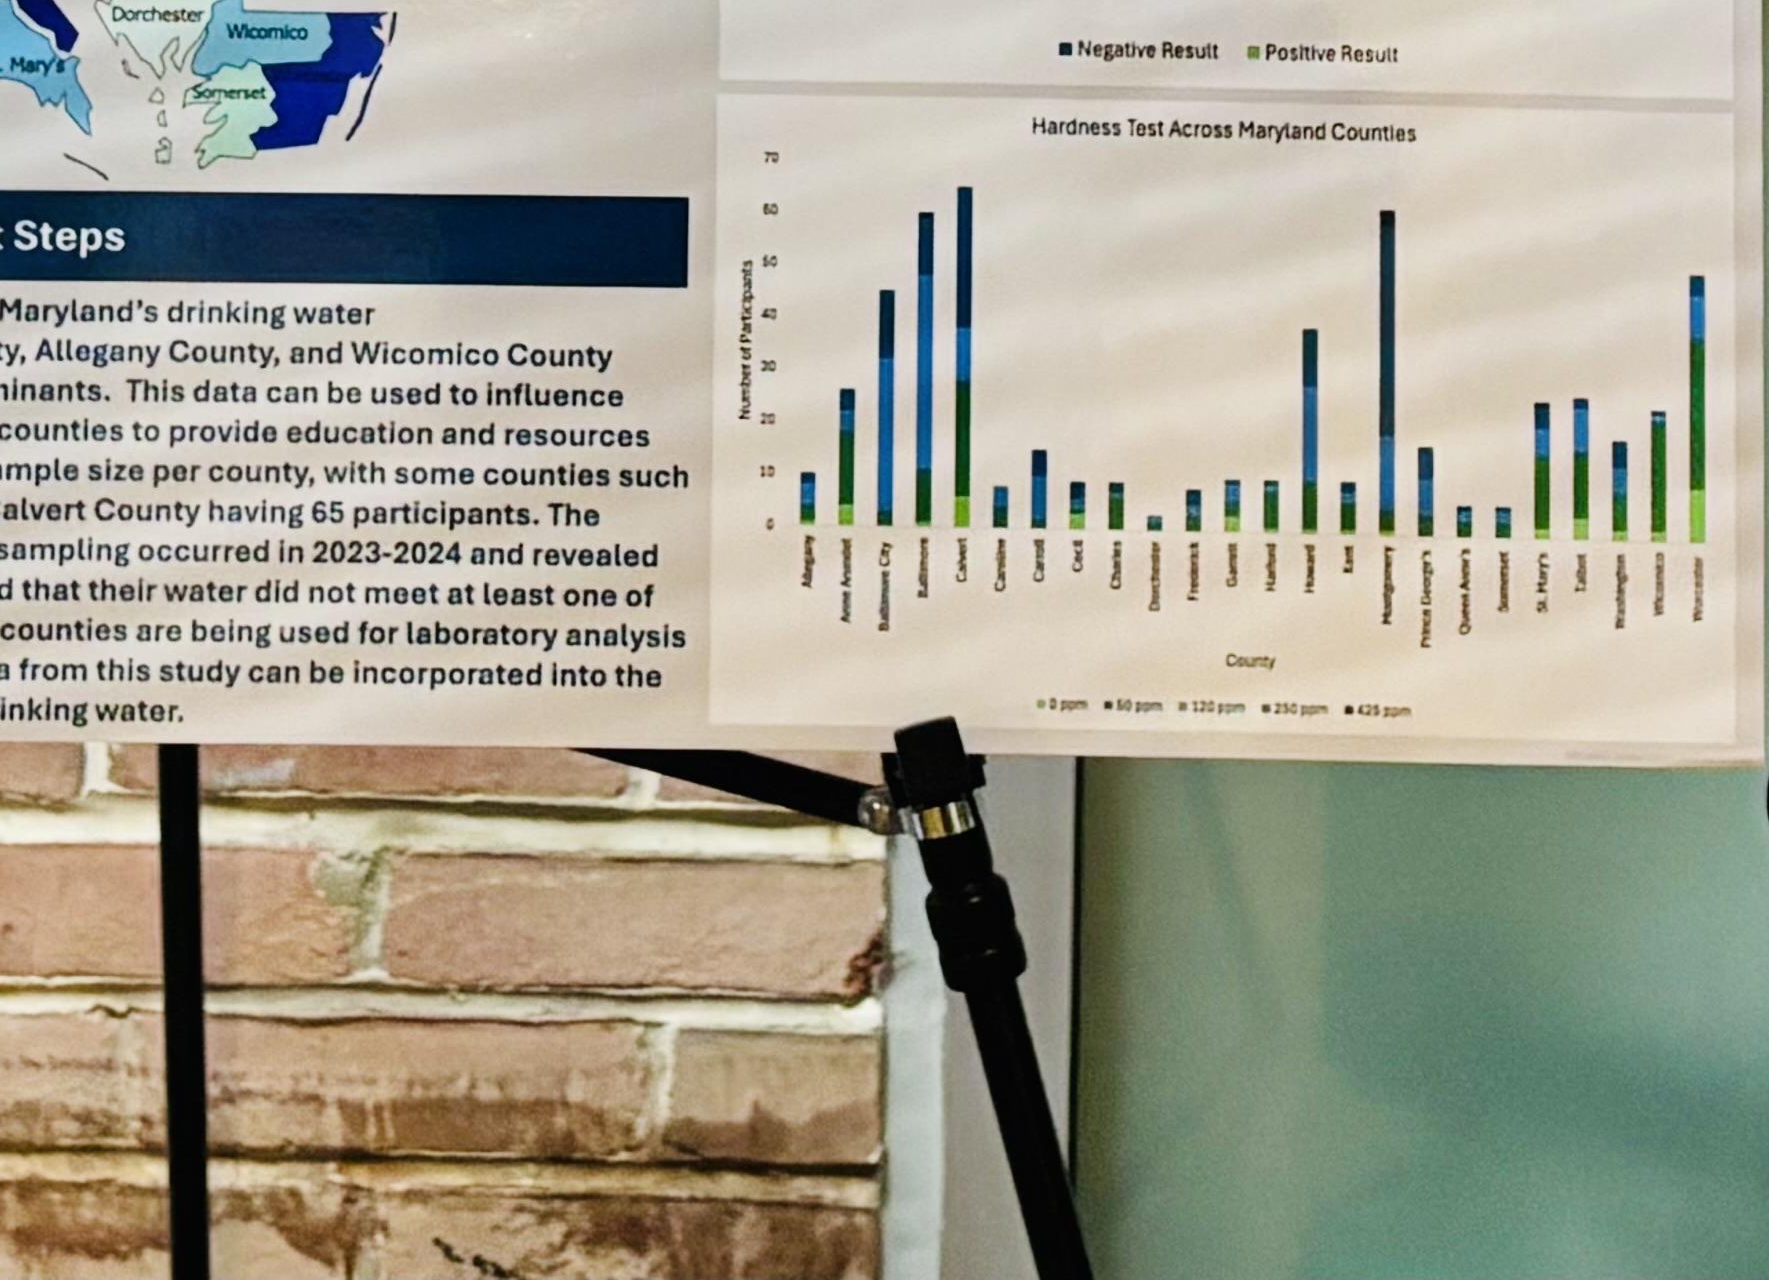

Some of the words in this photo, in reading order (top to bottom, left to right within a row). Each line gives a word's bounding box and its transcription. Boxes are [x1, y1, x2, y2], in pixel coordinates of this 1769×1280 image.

[112, 6, 204, 23] Dorchester
[226, 23, 307, 40] Wicomico
[192, 85, 266, 101] Somerset
[1031, 117, 1122, 137] Hardness
[1127, 118, 1165, 137] Test
[1167, 120, 1234, 140] Across
[1238, 121, 1327, 144] Maryland
[1330, 121, 1417, 143] Counties
[14, 219, 126, 259] Steps
